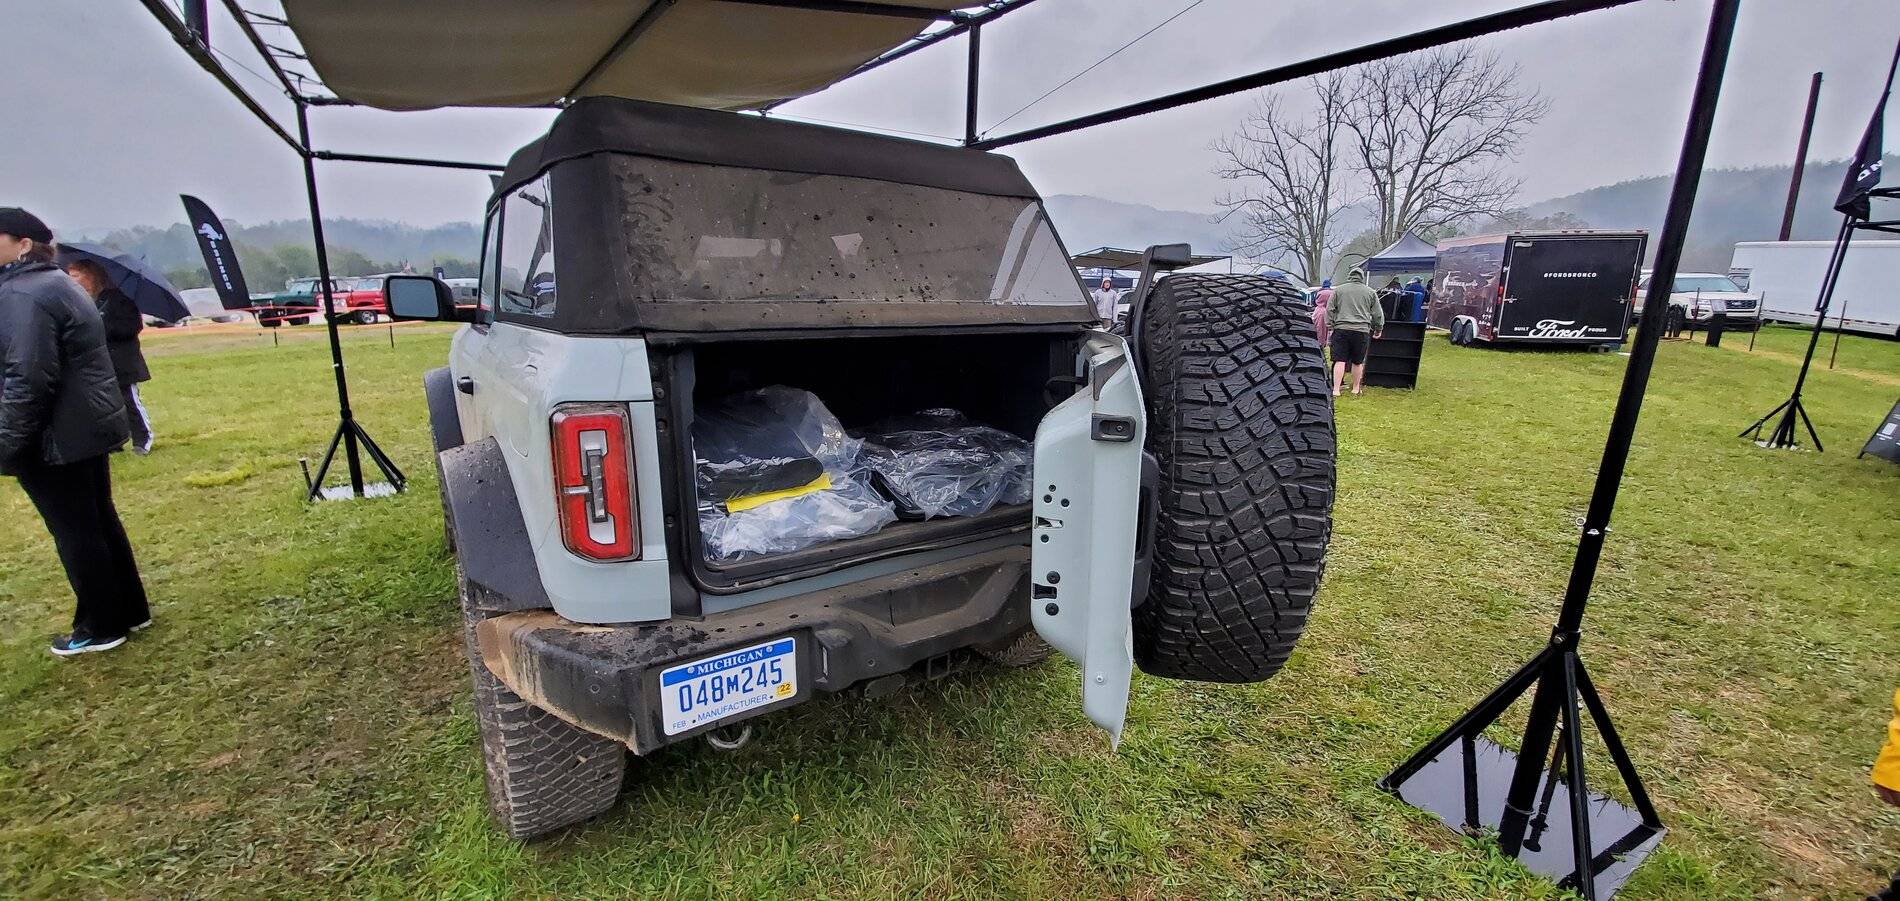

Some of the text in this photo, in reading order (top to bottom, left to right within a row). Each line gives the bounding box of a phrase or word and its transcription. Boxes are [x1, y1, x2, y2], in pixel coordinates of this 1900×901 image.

[210, 240, 233, 290] BRONCO
[1528, 319, 1589, 338] Ford
[697, 649, 764, 675] MICHIGAN
[679, 658, 782, 713] 048M245
[697, 693, 768, 722] MANUFACTURER
[672, 721, 687, 730] FEB
